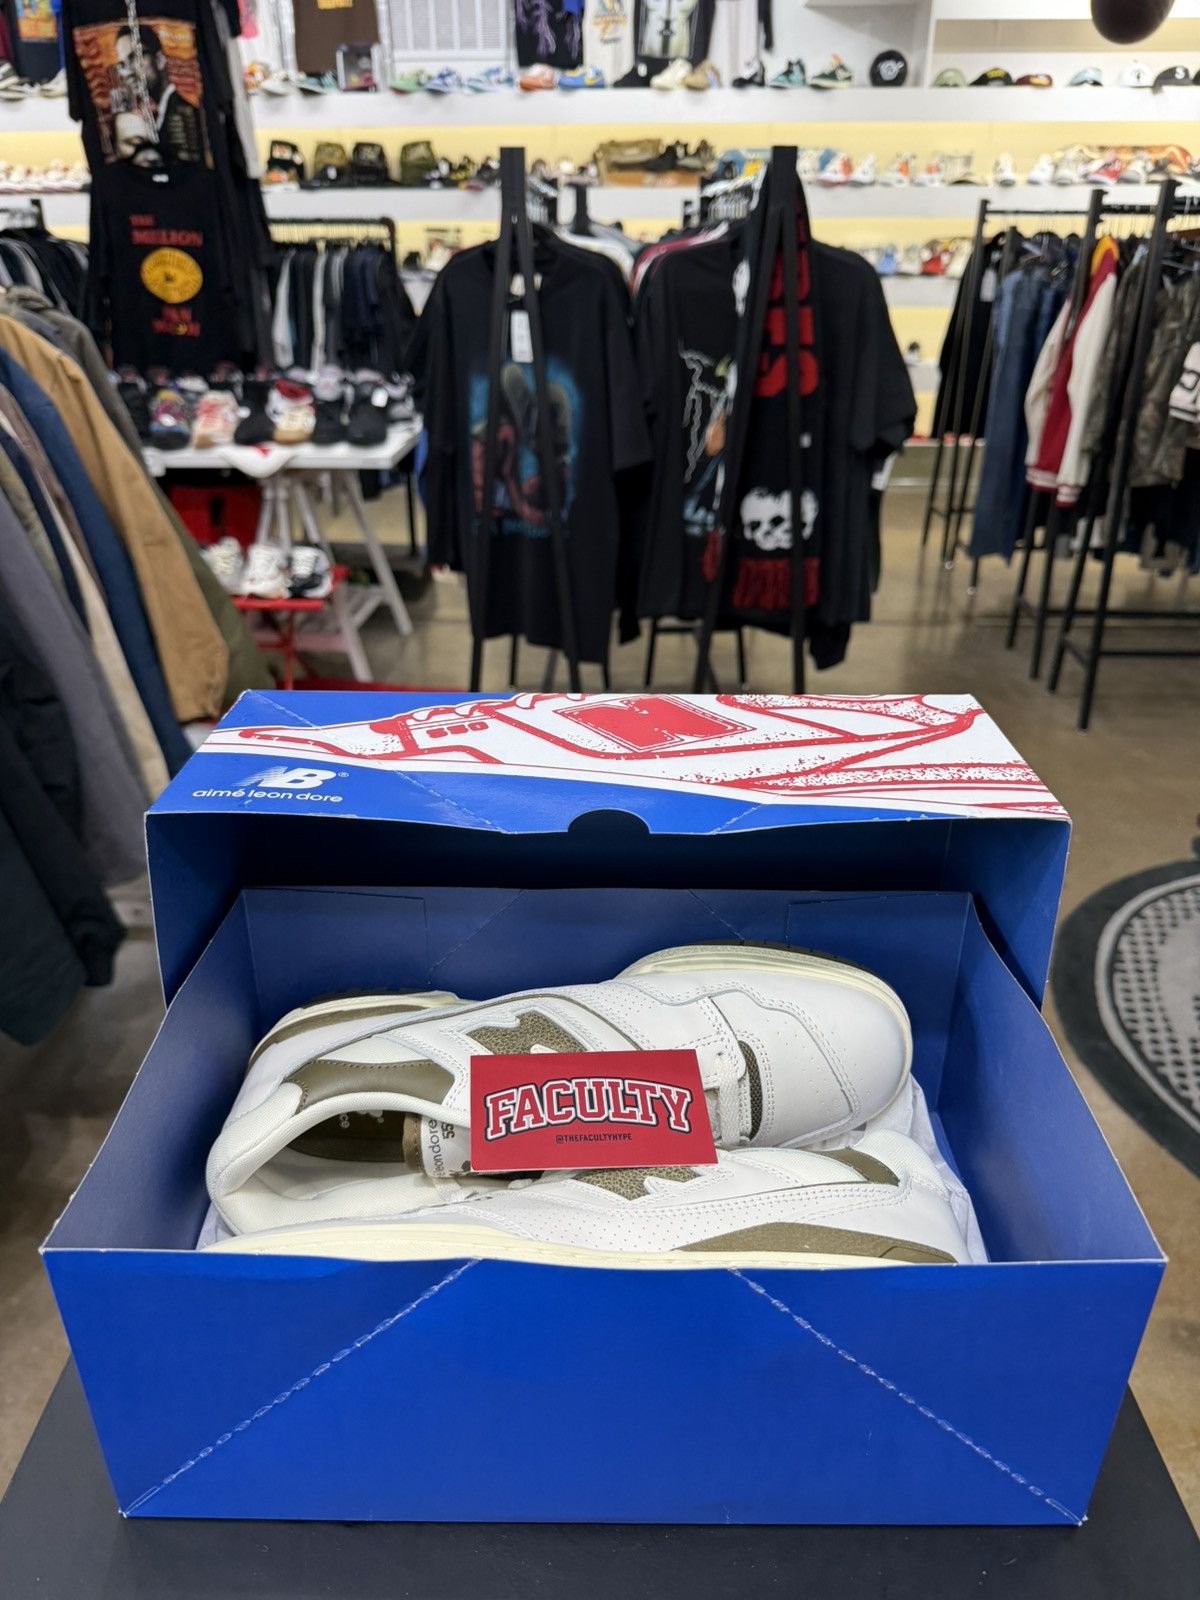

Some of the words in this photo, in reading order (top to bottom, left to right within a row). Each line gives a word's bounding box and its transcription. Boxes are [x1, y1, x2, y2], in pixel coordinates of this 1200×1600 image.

[192, 788, 246, 799] aimé
[248, 789, 293, 801] leon
[296, 792, 344, 803] dore
[484, 1076, 692, 1142] FACULTY
[428, 1118, 441, 1153] dore
[555, 1133, 633, 1145] @THEFACULTYHYPE
